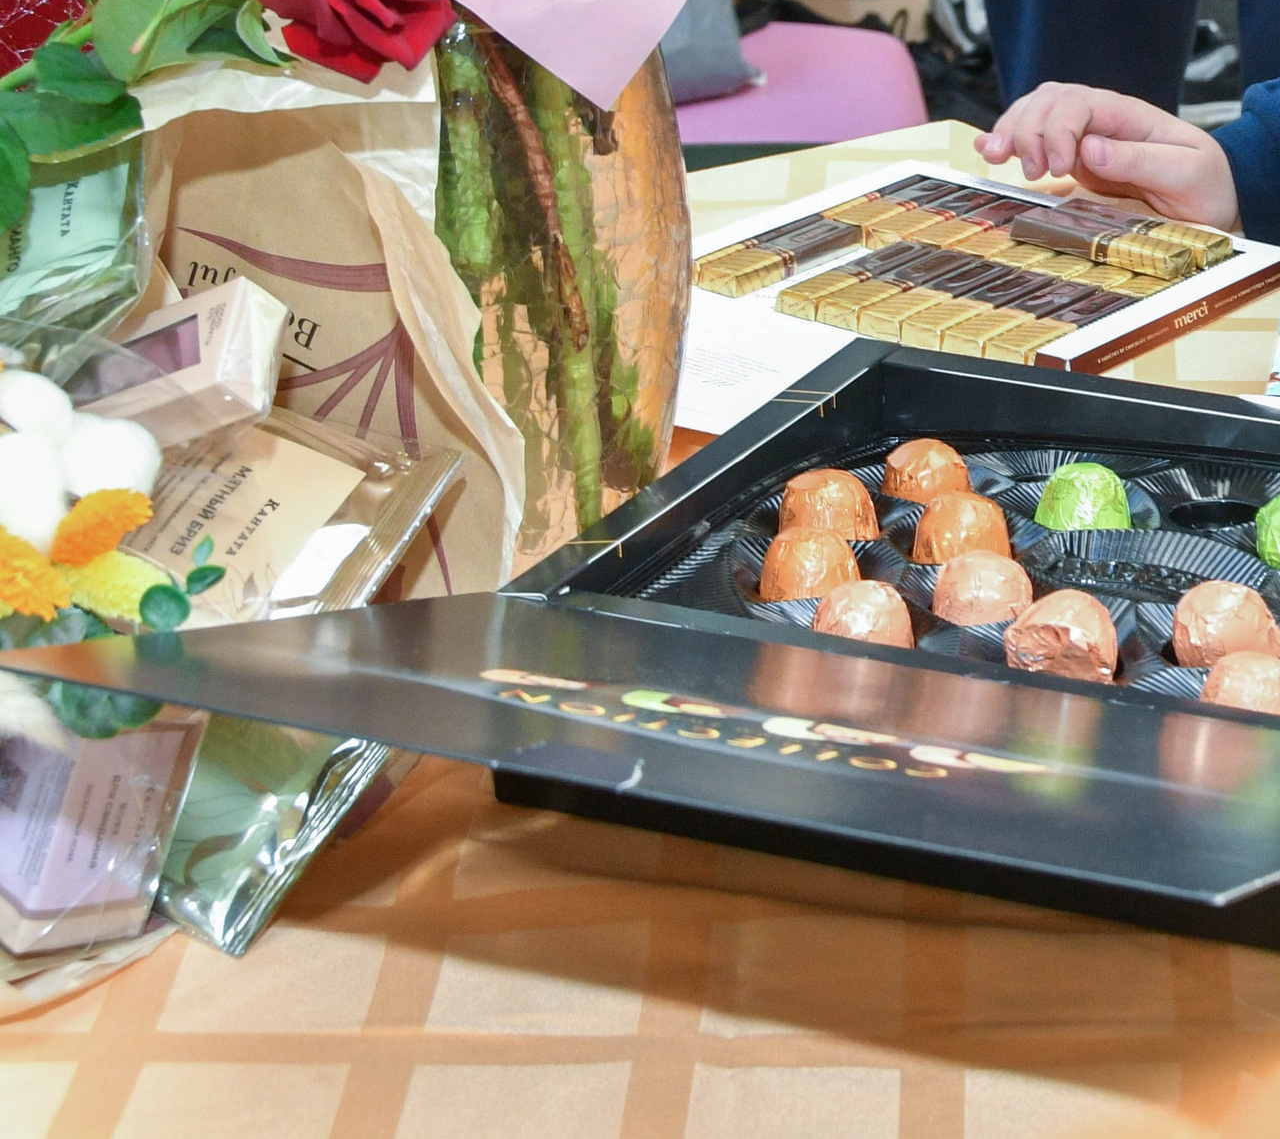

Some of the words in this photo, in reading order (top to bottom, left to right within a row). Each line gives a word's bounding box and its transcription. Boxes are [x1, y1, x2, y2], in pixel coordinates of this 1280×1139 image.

[1174, 301, 1209, 329] merci
[198, 465, 254, 521] МЯТНЫЙ
[170, 519, 205, 555] БРИЗ
